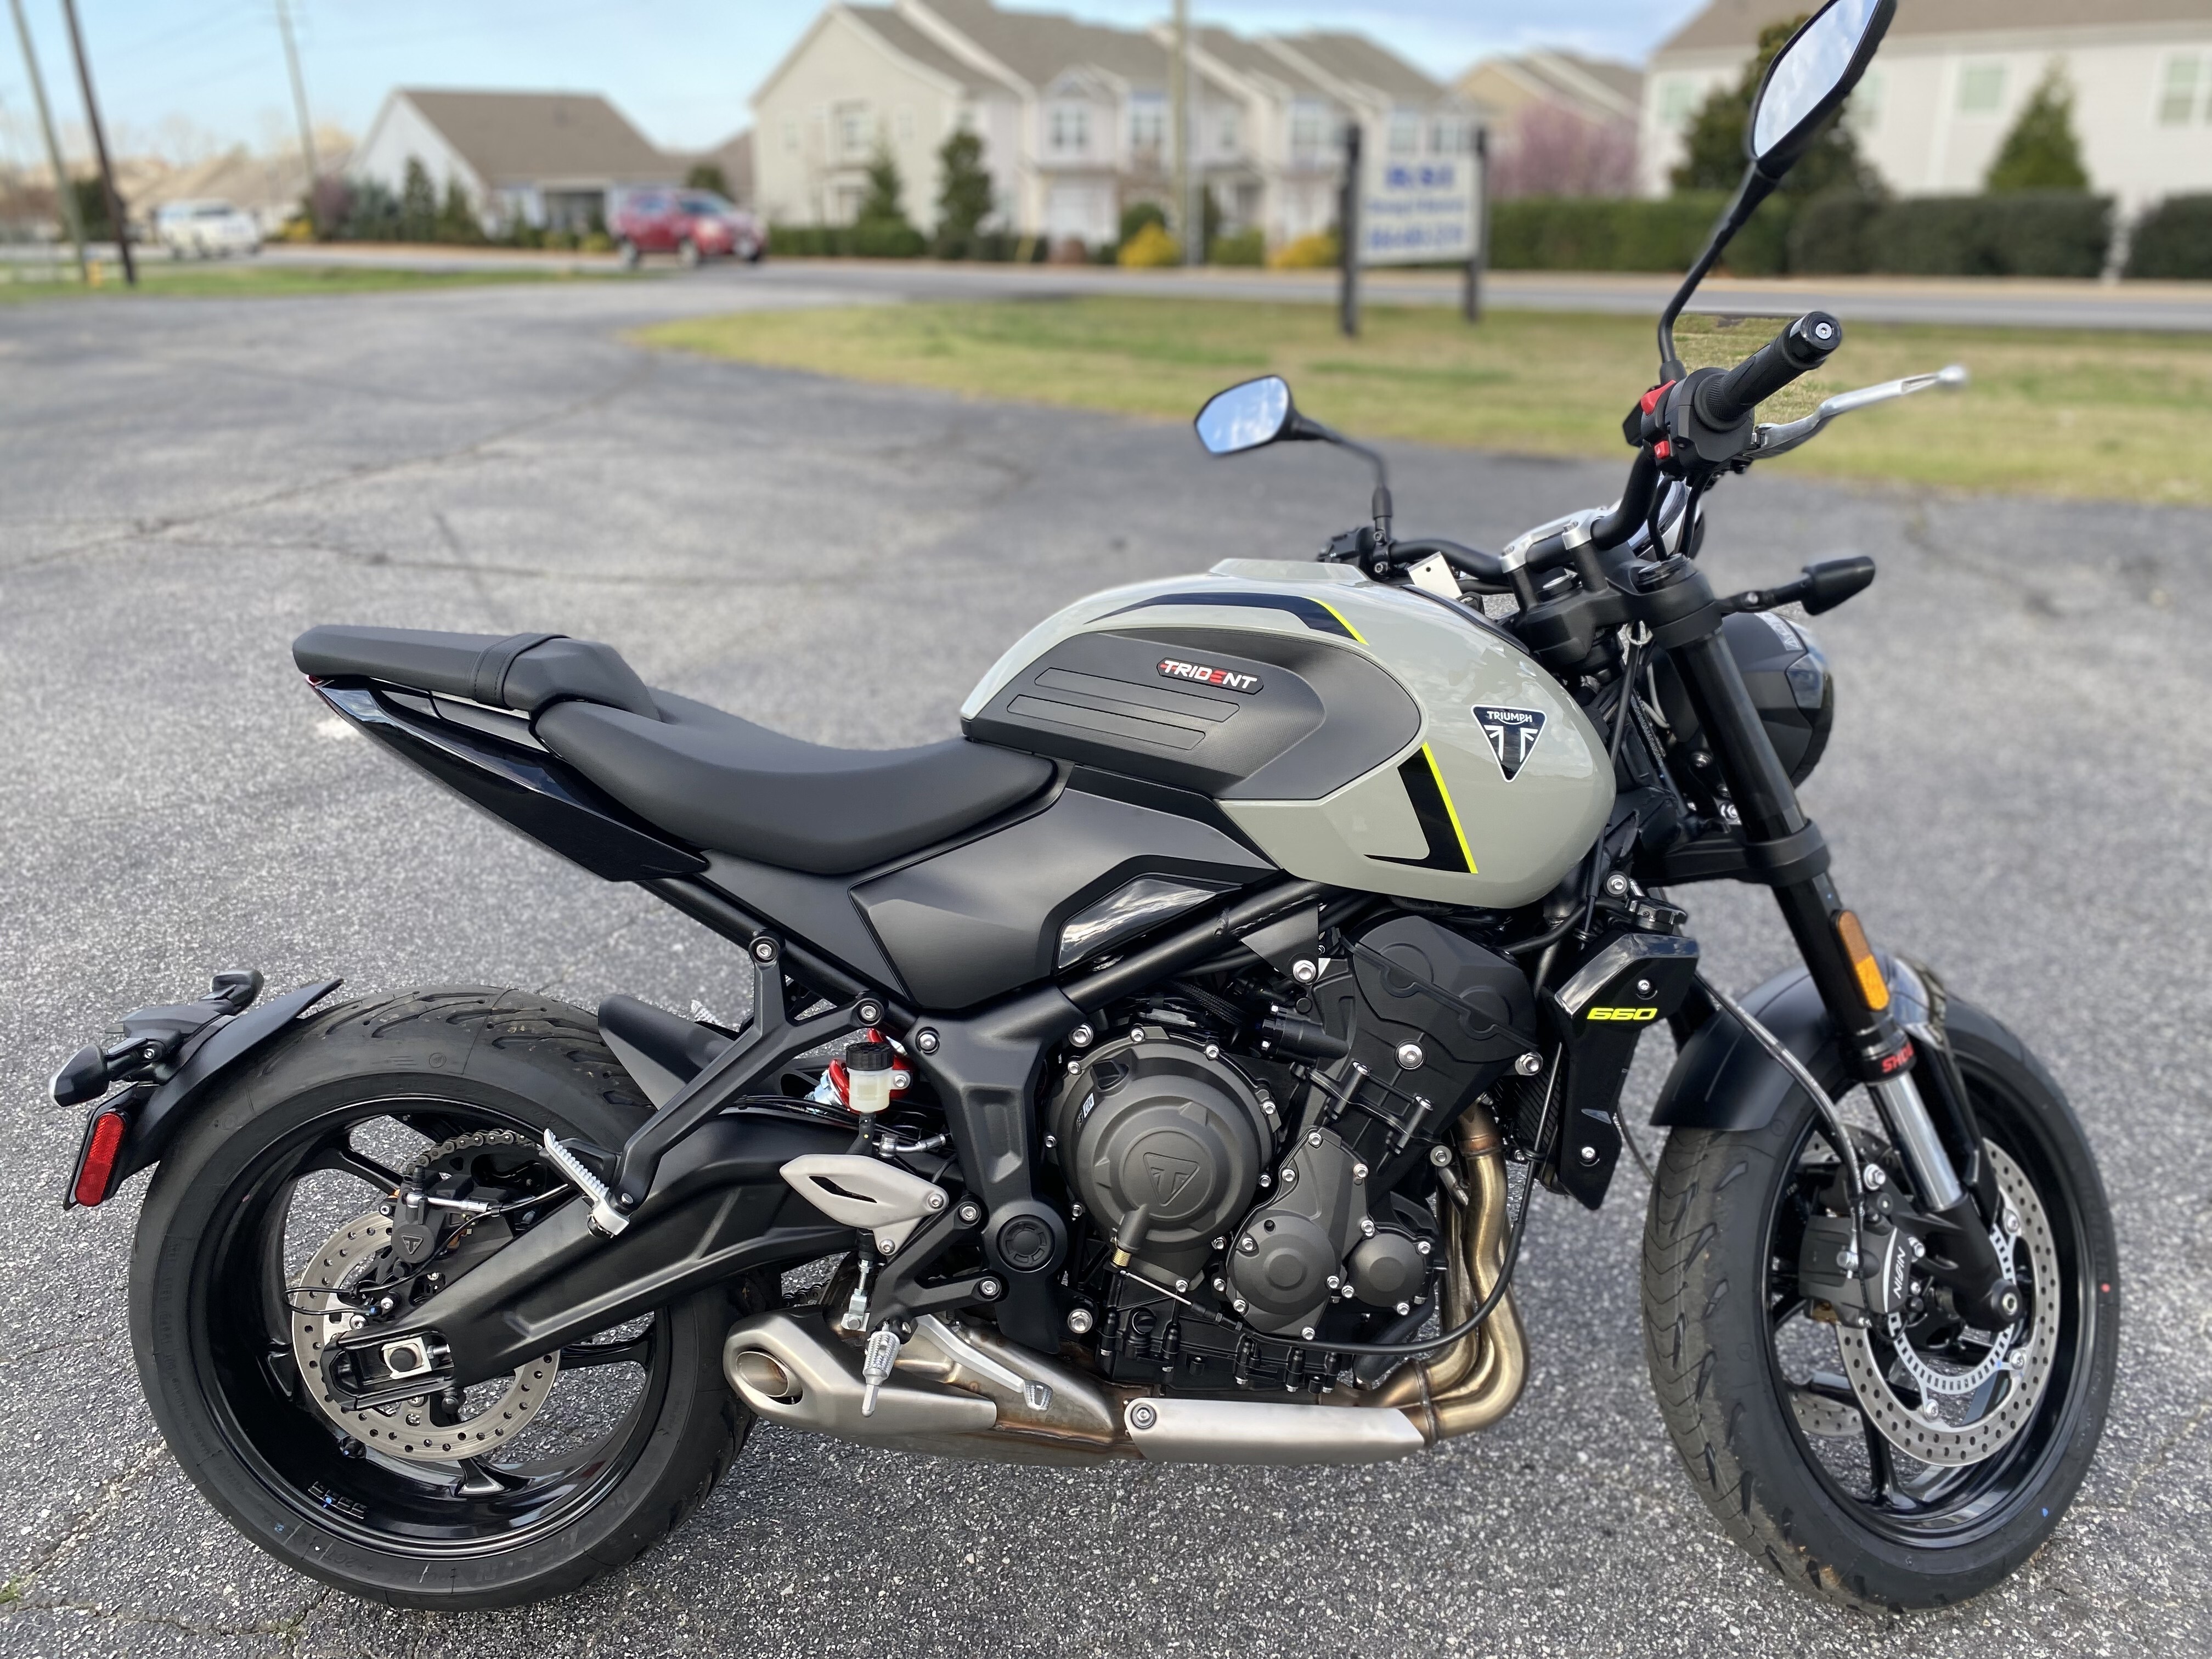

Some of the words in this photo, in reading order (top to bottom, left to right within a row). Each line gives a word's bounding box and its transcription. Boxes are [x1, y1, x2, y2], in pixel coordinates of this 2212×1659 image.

[1161, 660, 1257, 689] TRIDENT
[1486, 710, 1533, 724] TRIUMPH
[1587, 1007, 1657, 1020] 660
